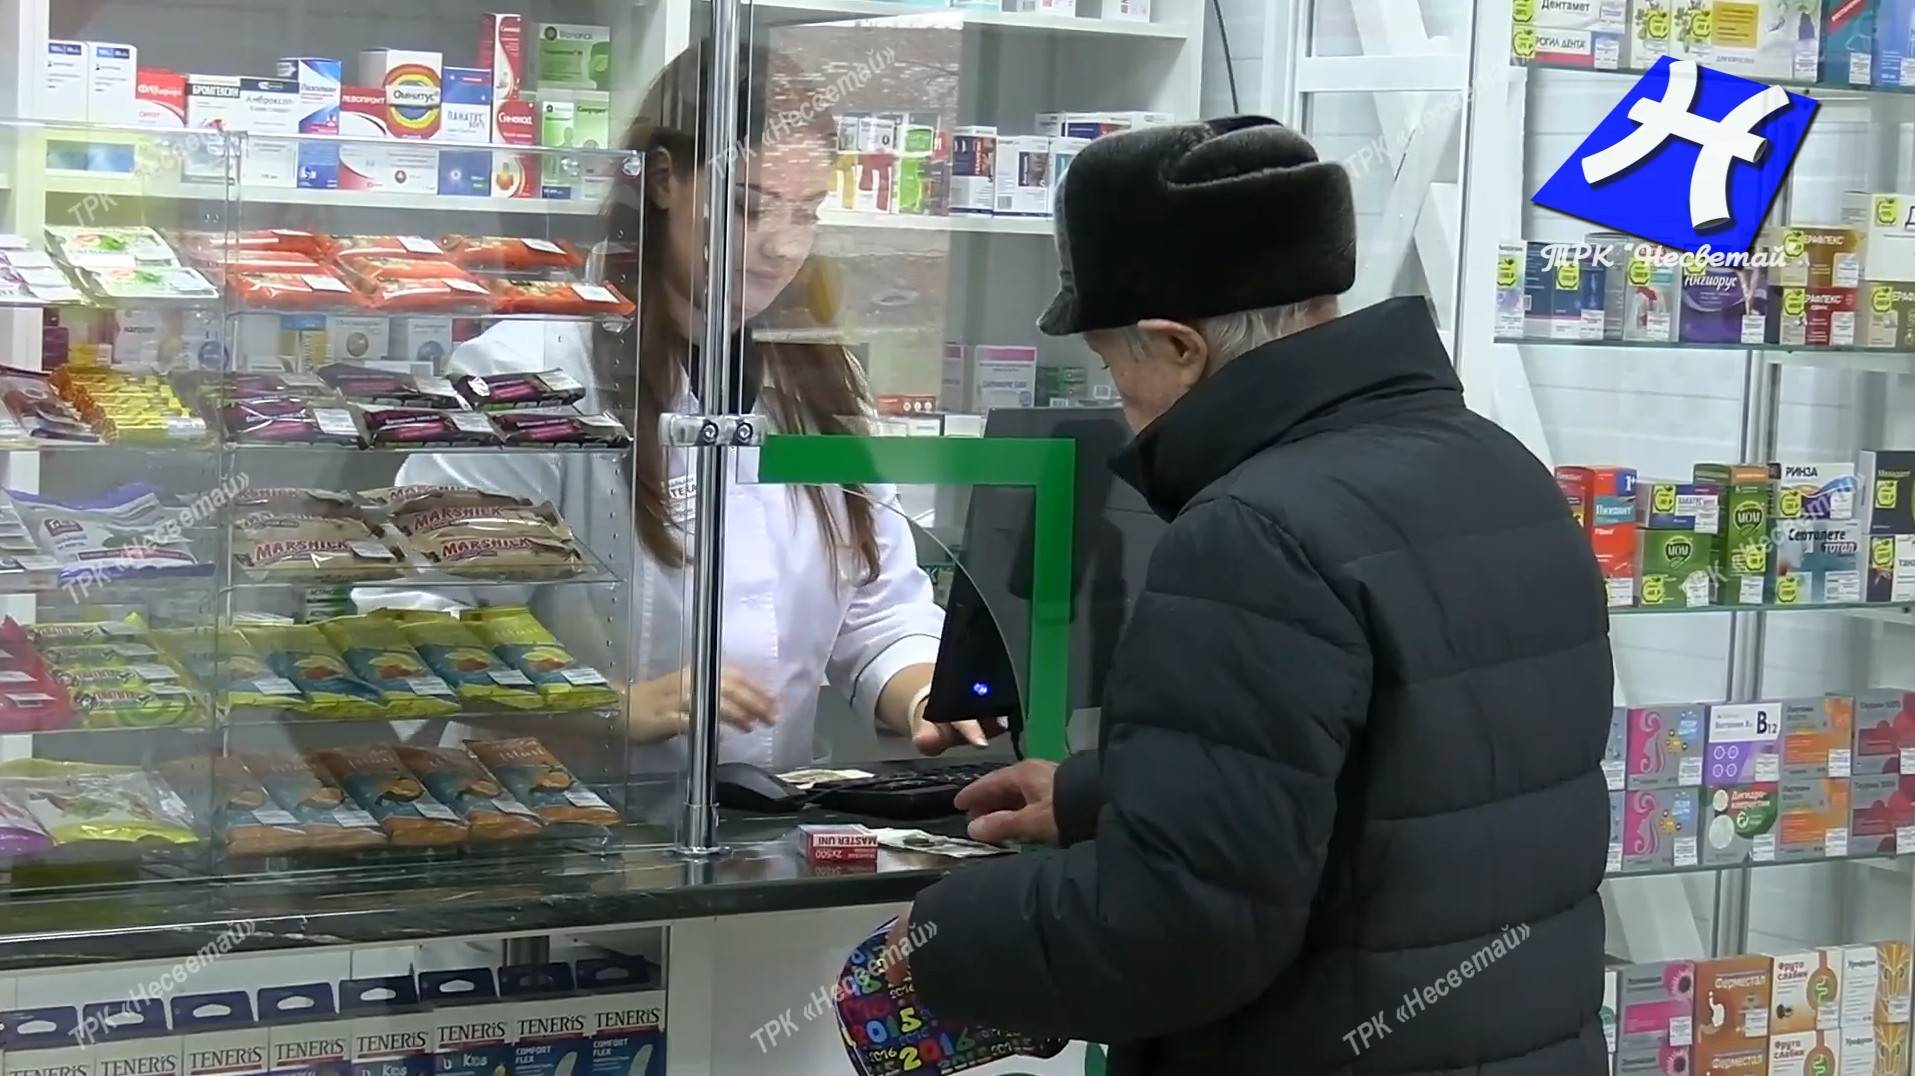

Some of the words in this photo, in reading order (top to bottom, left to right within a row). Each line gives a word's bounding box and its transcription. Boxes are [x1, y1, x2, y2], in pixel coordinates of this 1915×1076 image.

[1785, 466, 1818, 478] РИНЗА
[818, 836, 837, 848] UNI
[841, 835, 878, 846] MASTER
